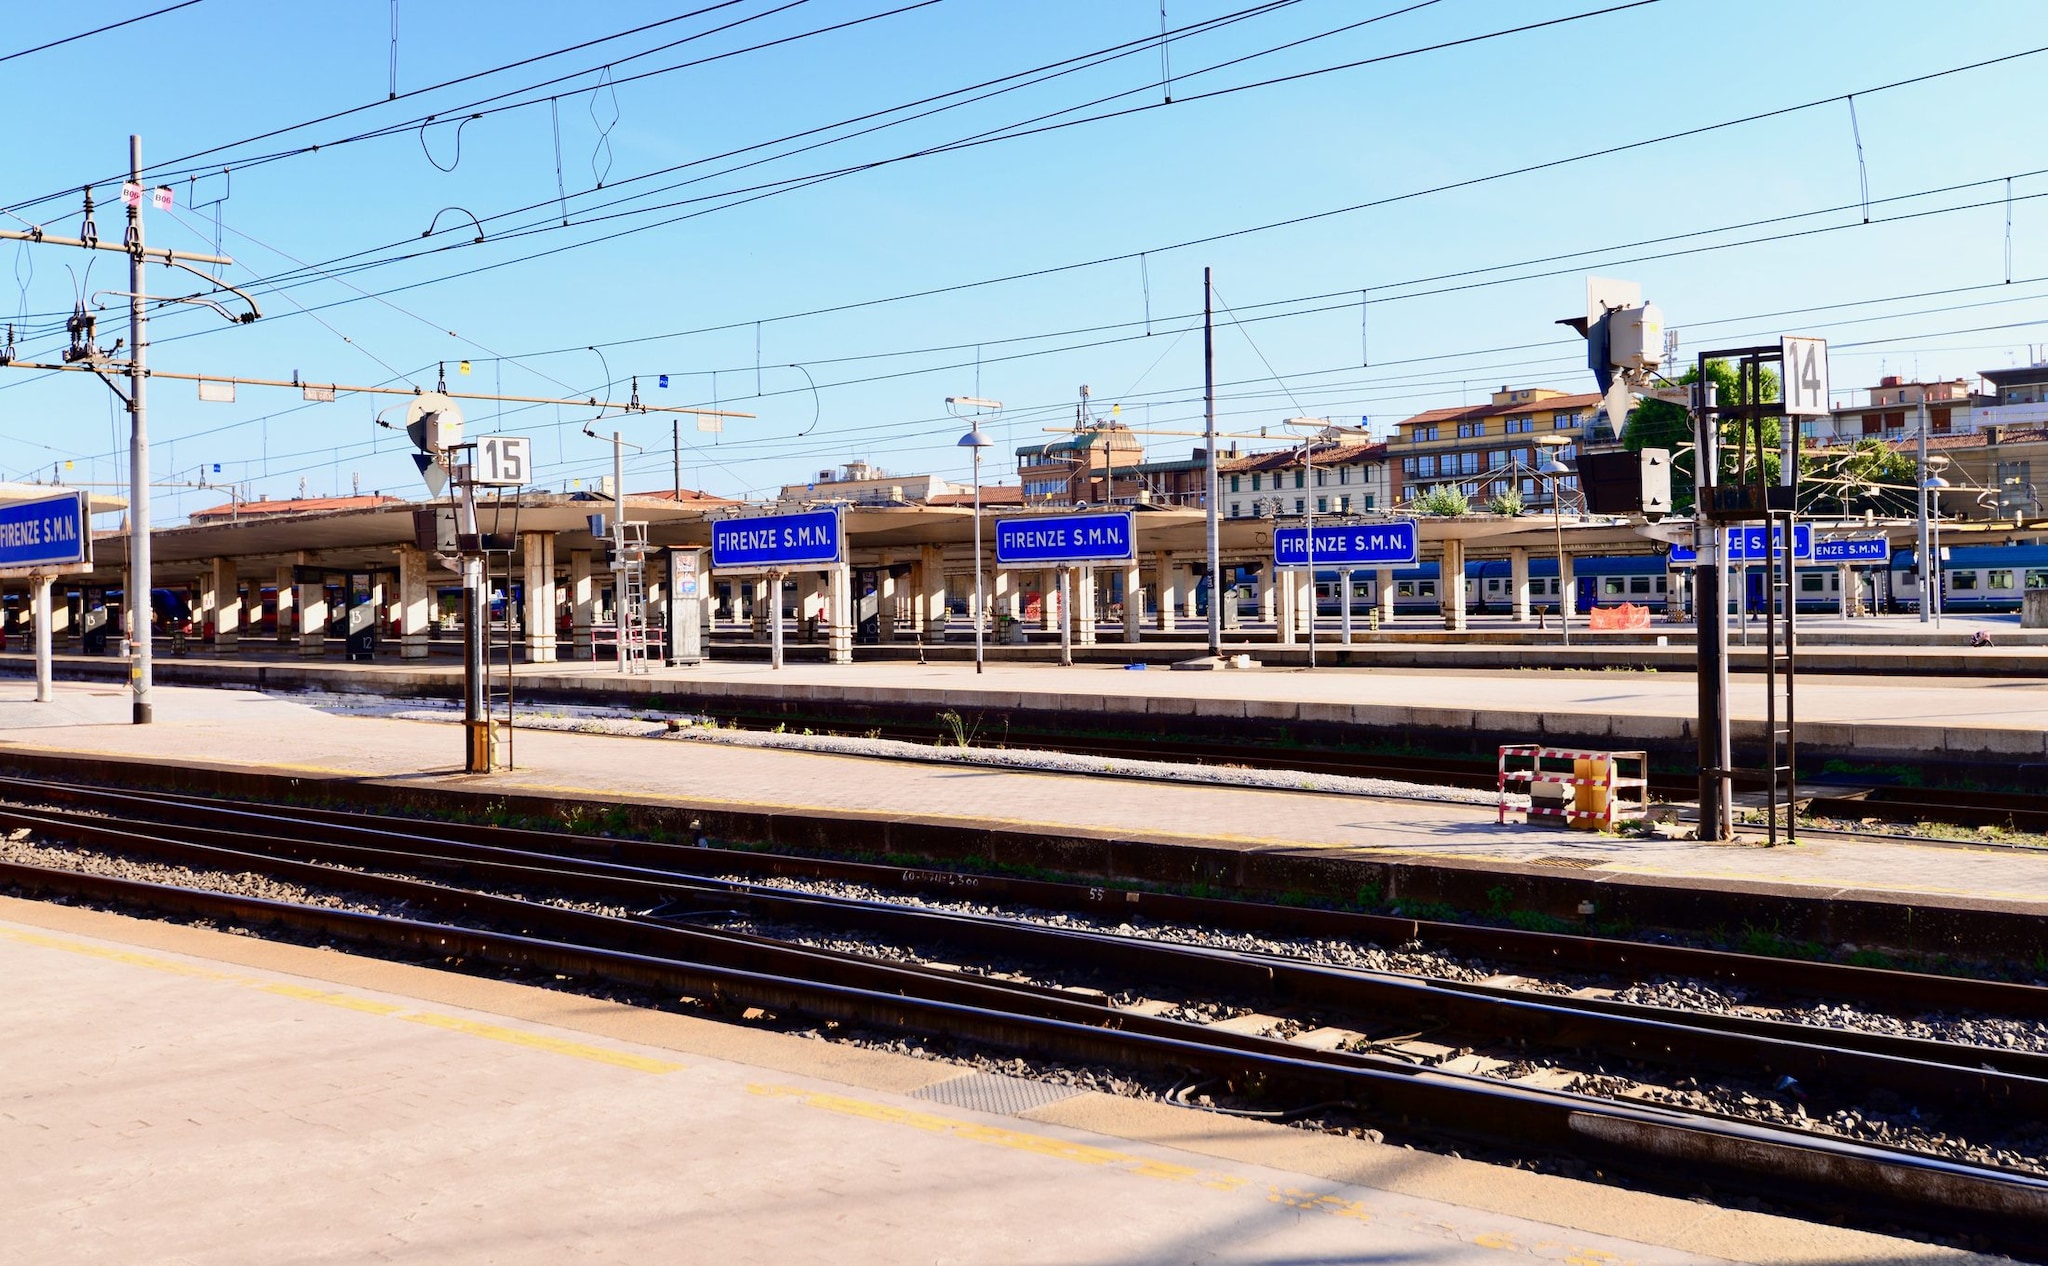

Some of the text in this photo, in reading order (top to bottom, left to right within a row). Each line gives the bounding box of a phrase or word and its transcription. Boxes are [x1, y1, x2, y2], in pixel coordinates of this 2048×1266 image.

[155, 194, 171, 204] B06
[1789, 341, 1821, 407] 14
[486, 440, 521, 479] 15
[0, 514, 76, 548] FIRENZE S.M.N.
[718, 525, 831, 551] FIRENZE S.M.N.
[1003, 527, 1123, 549] FIRENZE S.M.N.
[1355, 534, 1407, 551] S.M.N.
[1816, 544, 1882, 556] ENZE S.M.N.
[352, 610, 361, 624] 13
[362, 636, 372, 650] 12
